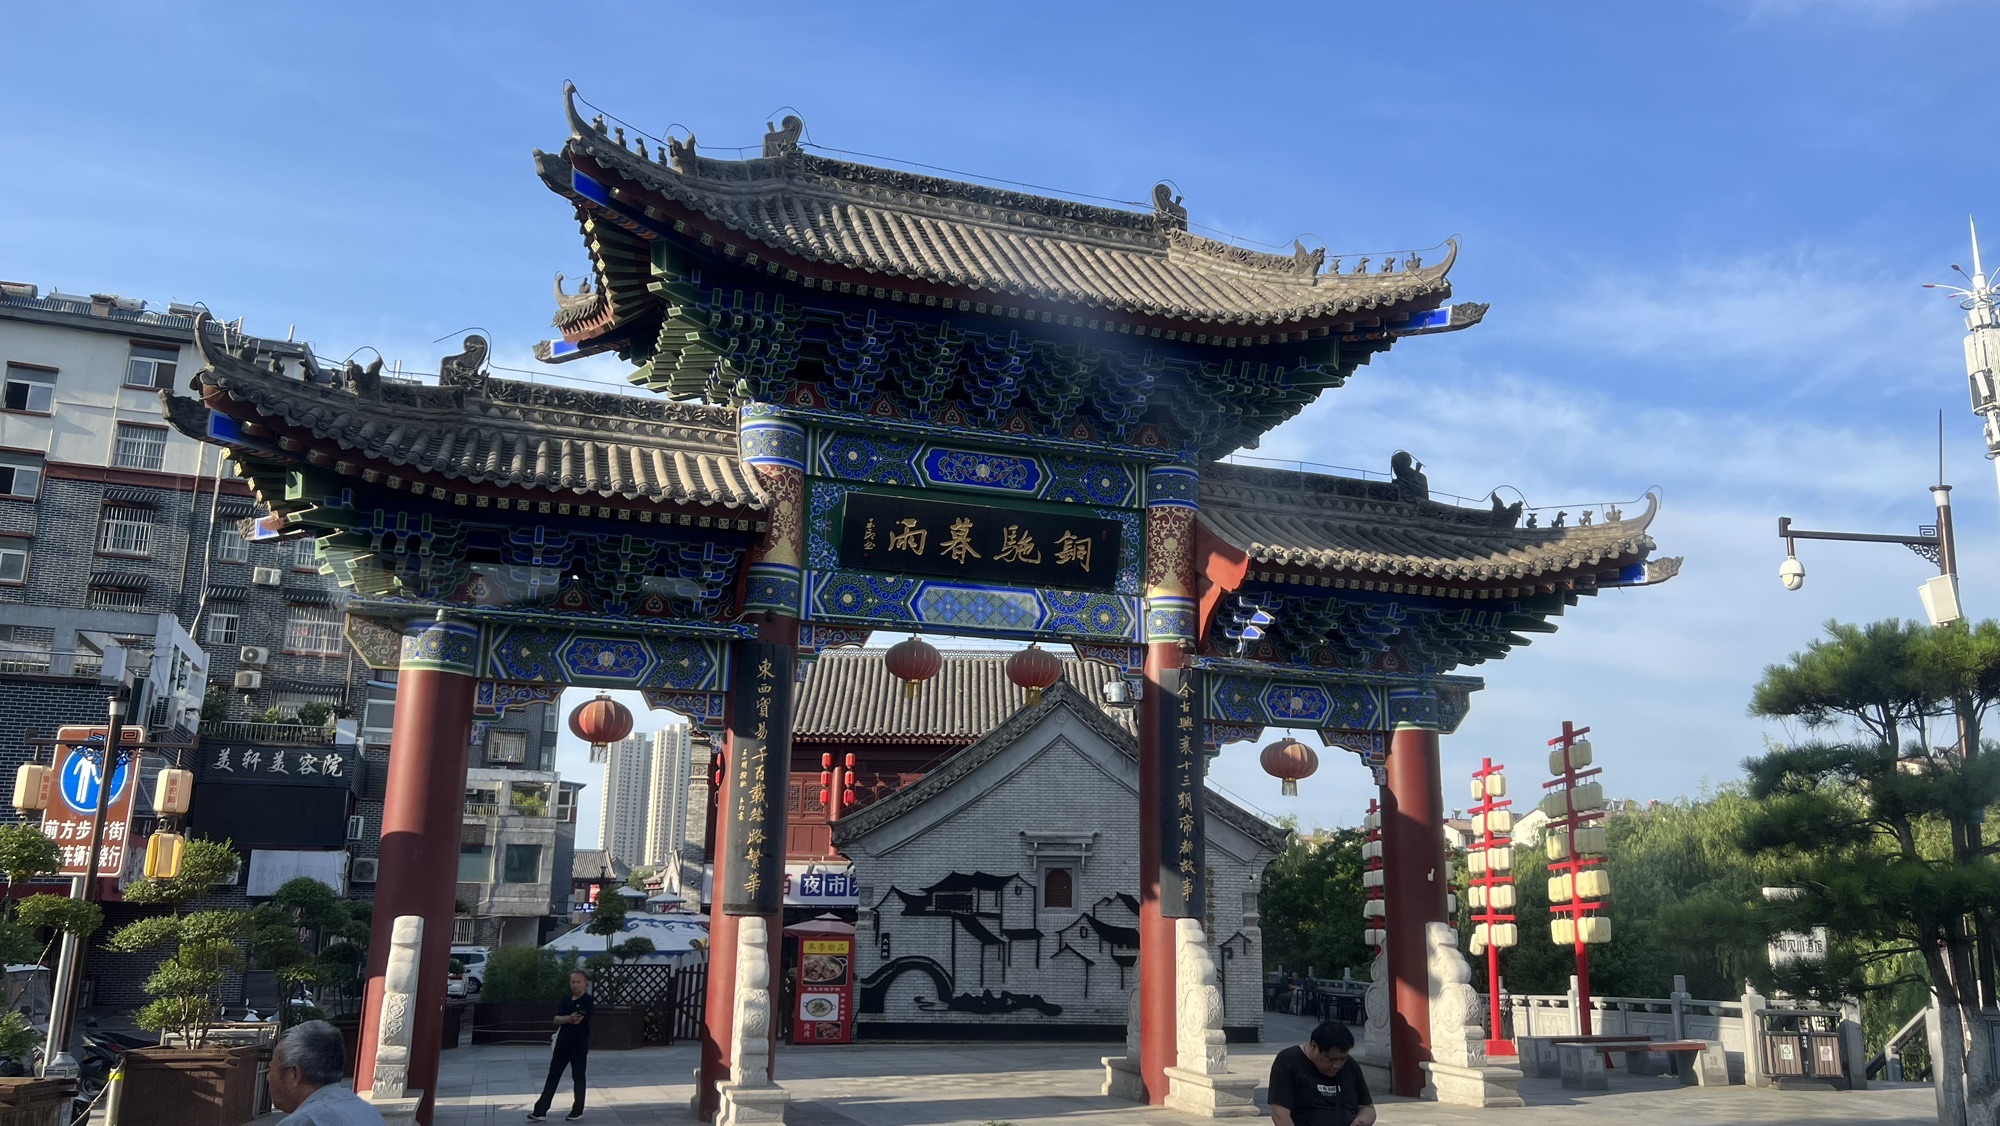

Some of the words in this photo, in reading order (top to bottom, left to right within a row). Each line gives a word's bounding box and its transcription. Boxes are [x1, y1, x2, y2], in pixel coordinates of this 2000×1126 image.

[212, 747, 344, 777] 美轩美容院
